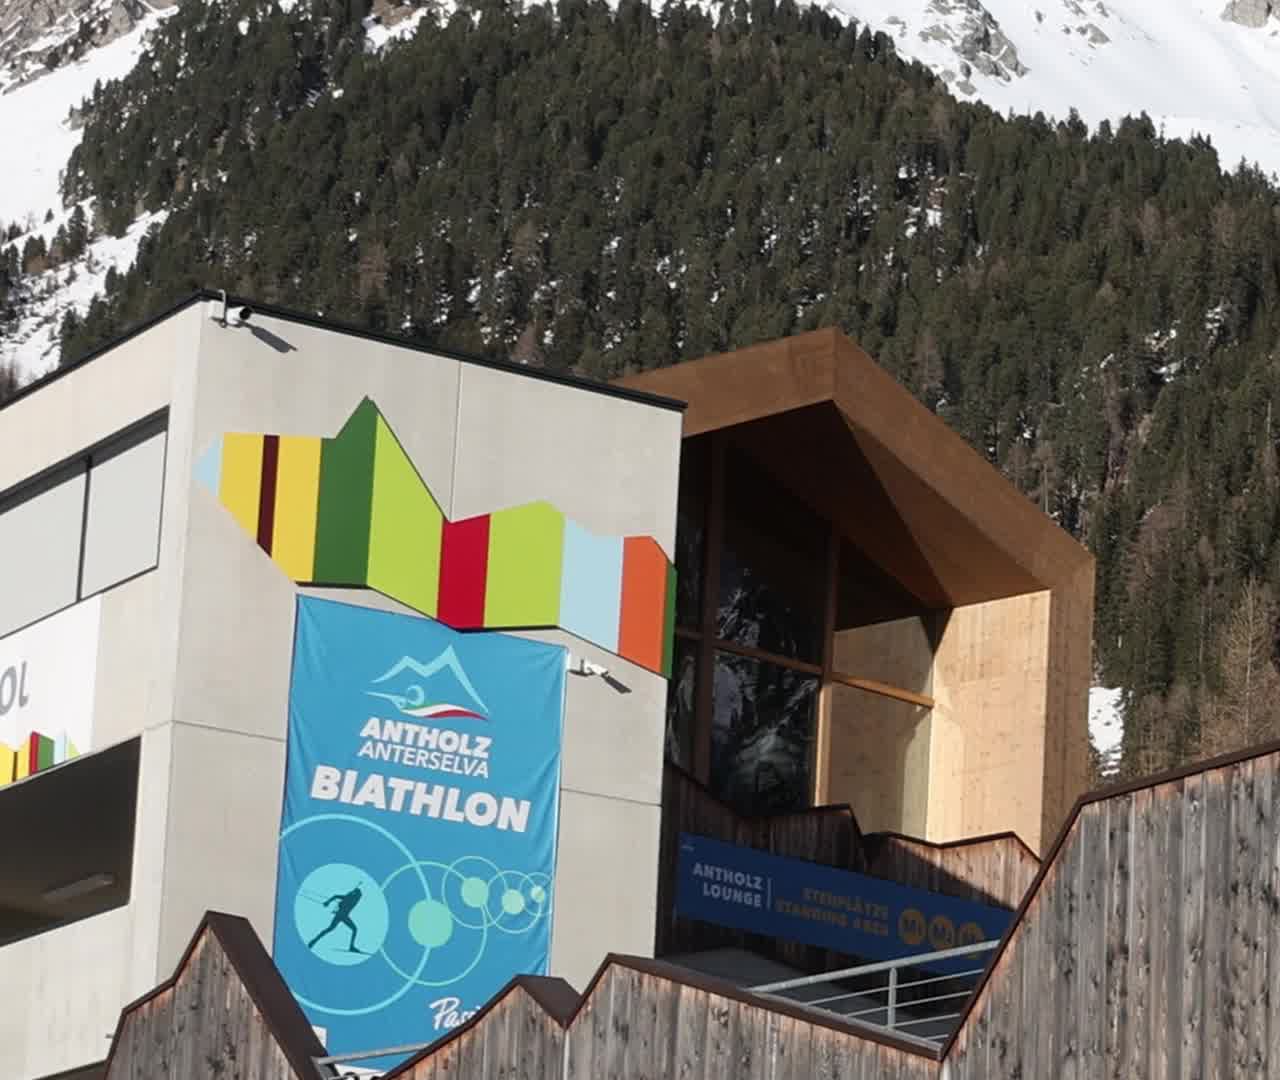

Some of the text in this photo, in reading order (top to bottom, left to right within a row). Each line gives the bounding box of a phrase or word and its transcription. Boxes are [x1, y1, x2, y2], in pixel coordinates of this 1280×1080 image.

[359, 717, 492, 758] ANTHOLZ
[357, 741, 489, 779] ANTERSELVA
[310, 764, 531, 833] BIATHLON
[692, 862, 763, 890] ANTHOLZ
[702, 881, 762, 908] LOUNGE
